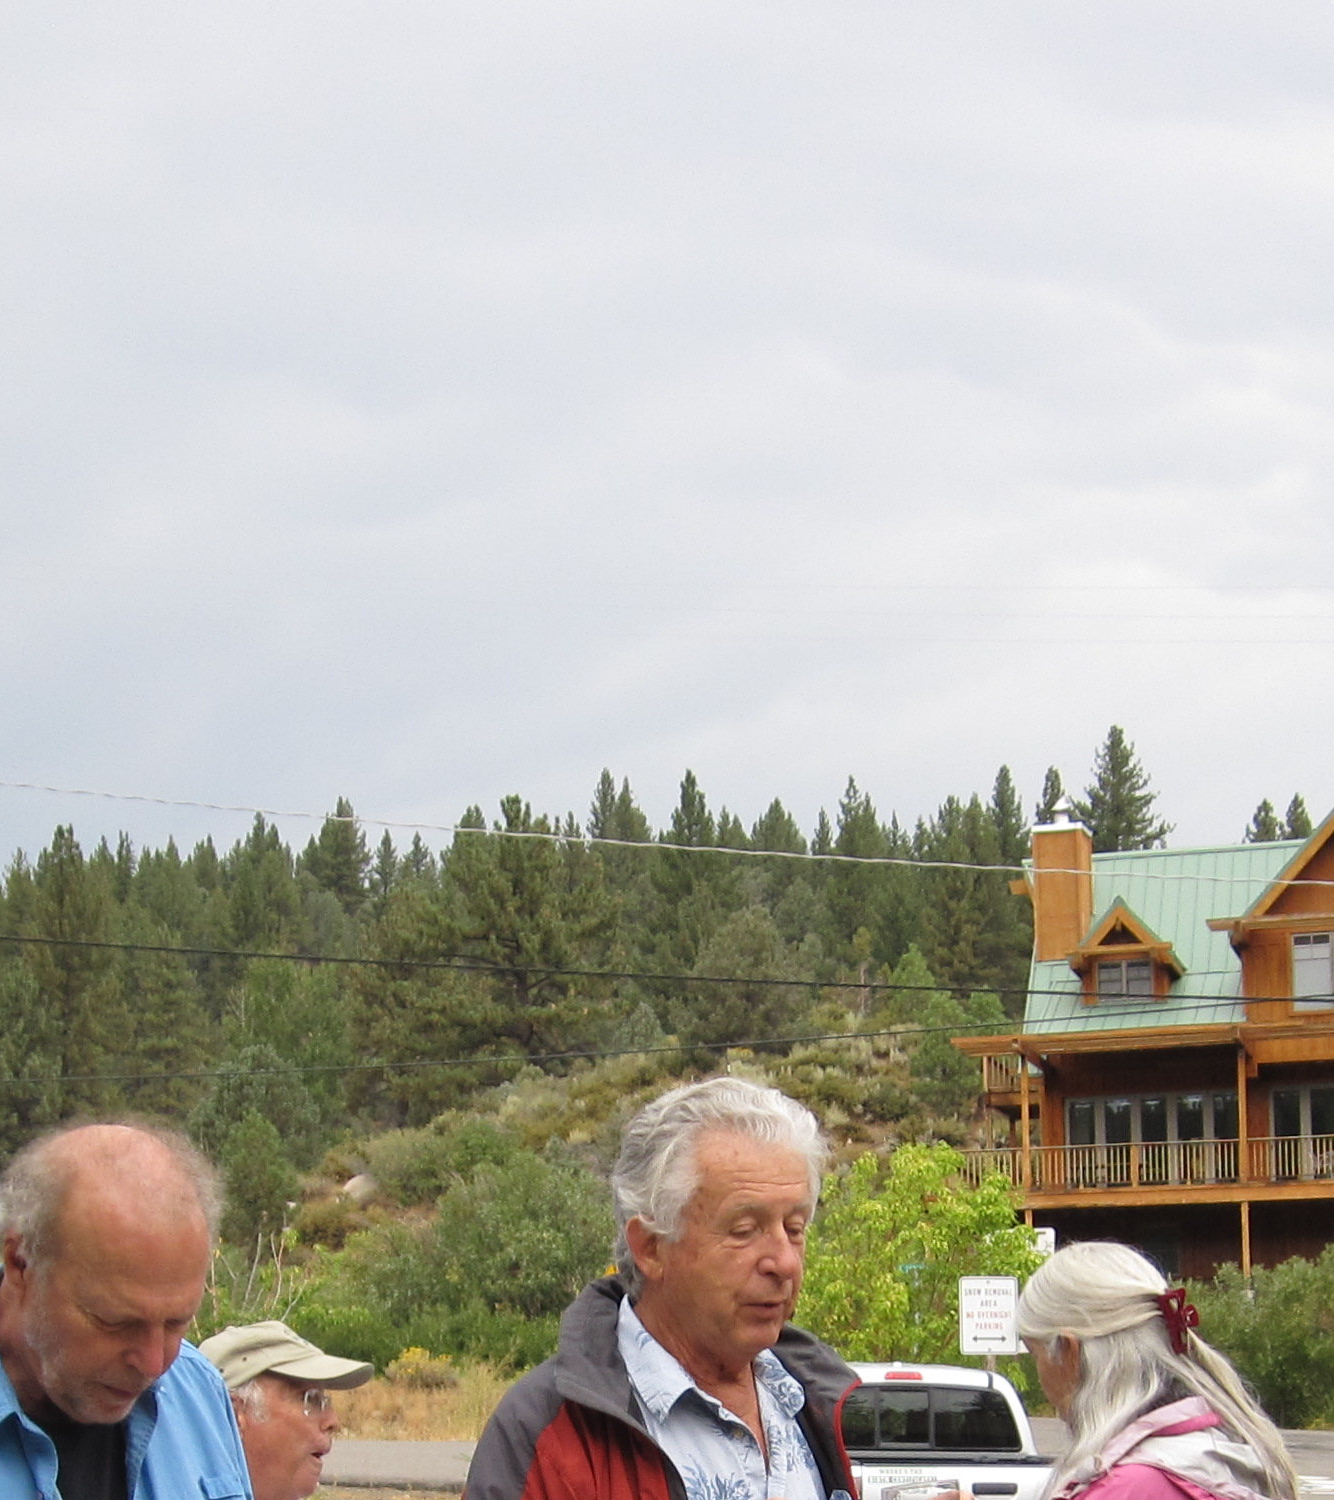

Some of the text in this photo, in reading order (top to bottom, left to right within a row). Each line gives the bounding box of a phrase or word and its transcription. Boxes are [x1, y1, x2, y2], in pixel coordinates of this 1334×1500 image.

[964, 1288, 1013, 1296] SNOW REMOVAL
[966, 1311, 1012, 1319] NO OVERNIGHT
[975, 1322, 1004, 1330] PARKING
